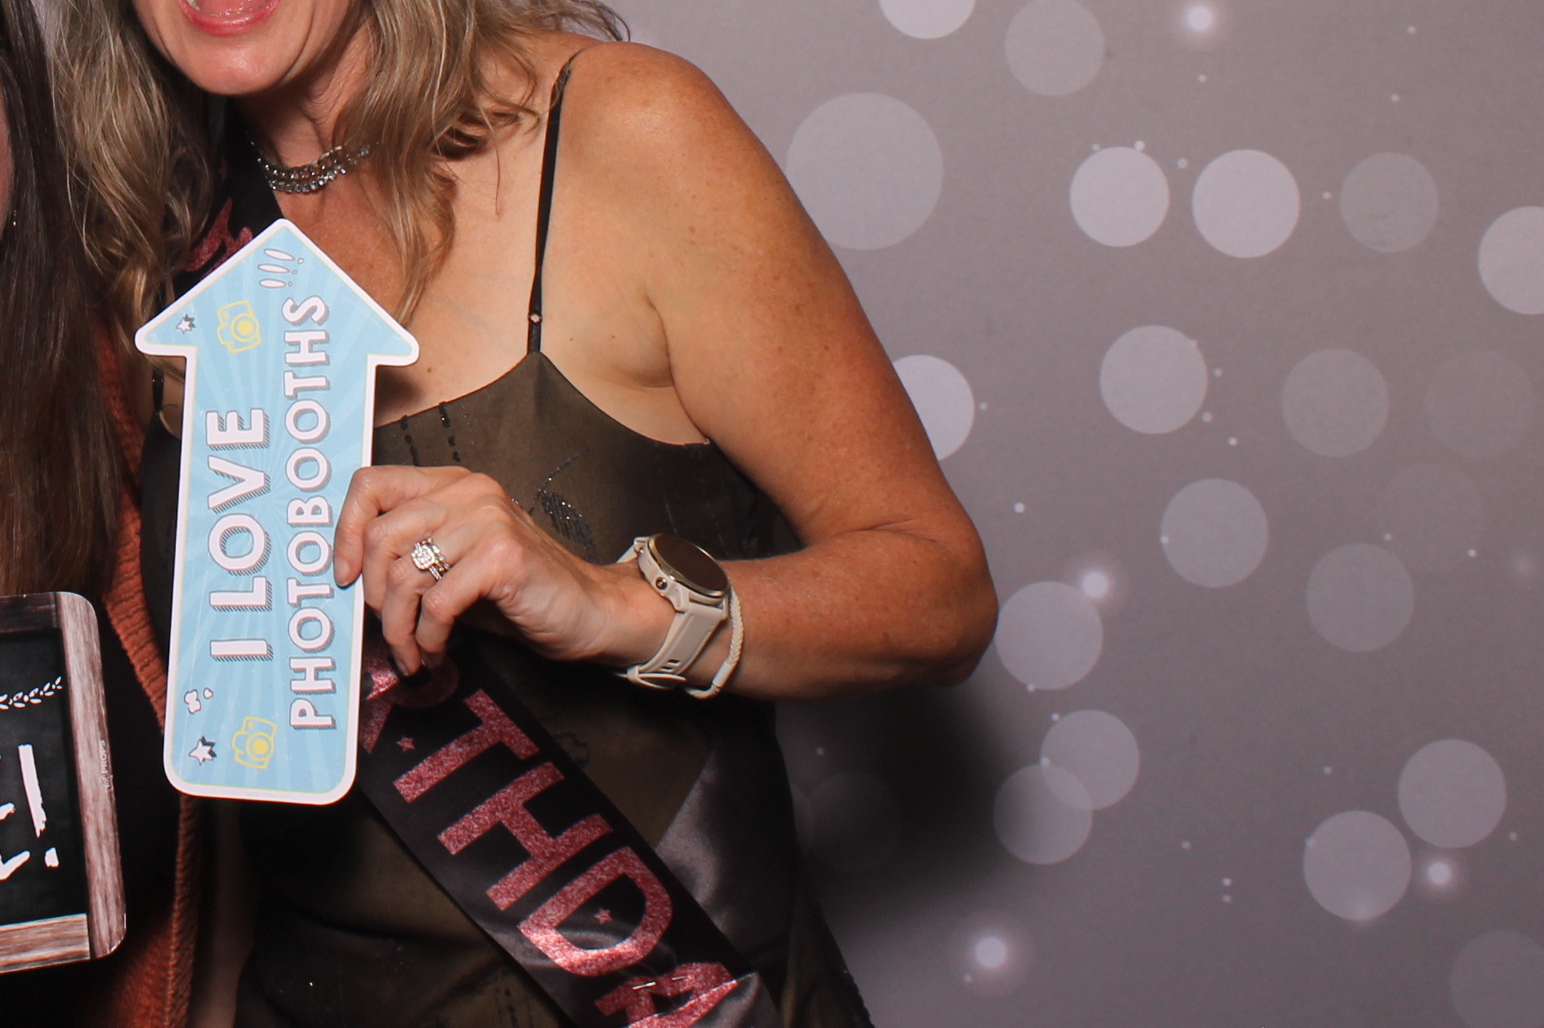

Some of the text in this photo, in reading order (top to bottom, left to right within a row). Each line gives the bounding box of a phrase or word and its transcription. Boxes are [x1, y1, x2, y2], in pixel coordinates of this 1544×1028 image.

[205, 407, 274, 662] I LOVE
[281, 294, 338, 731] PHOTOBOOTHS
